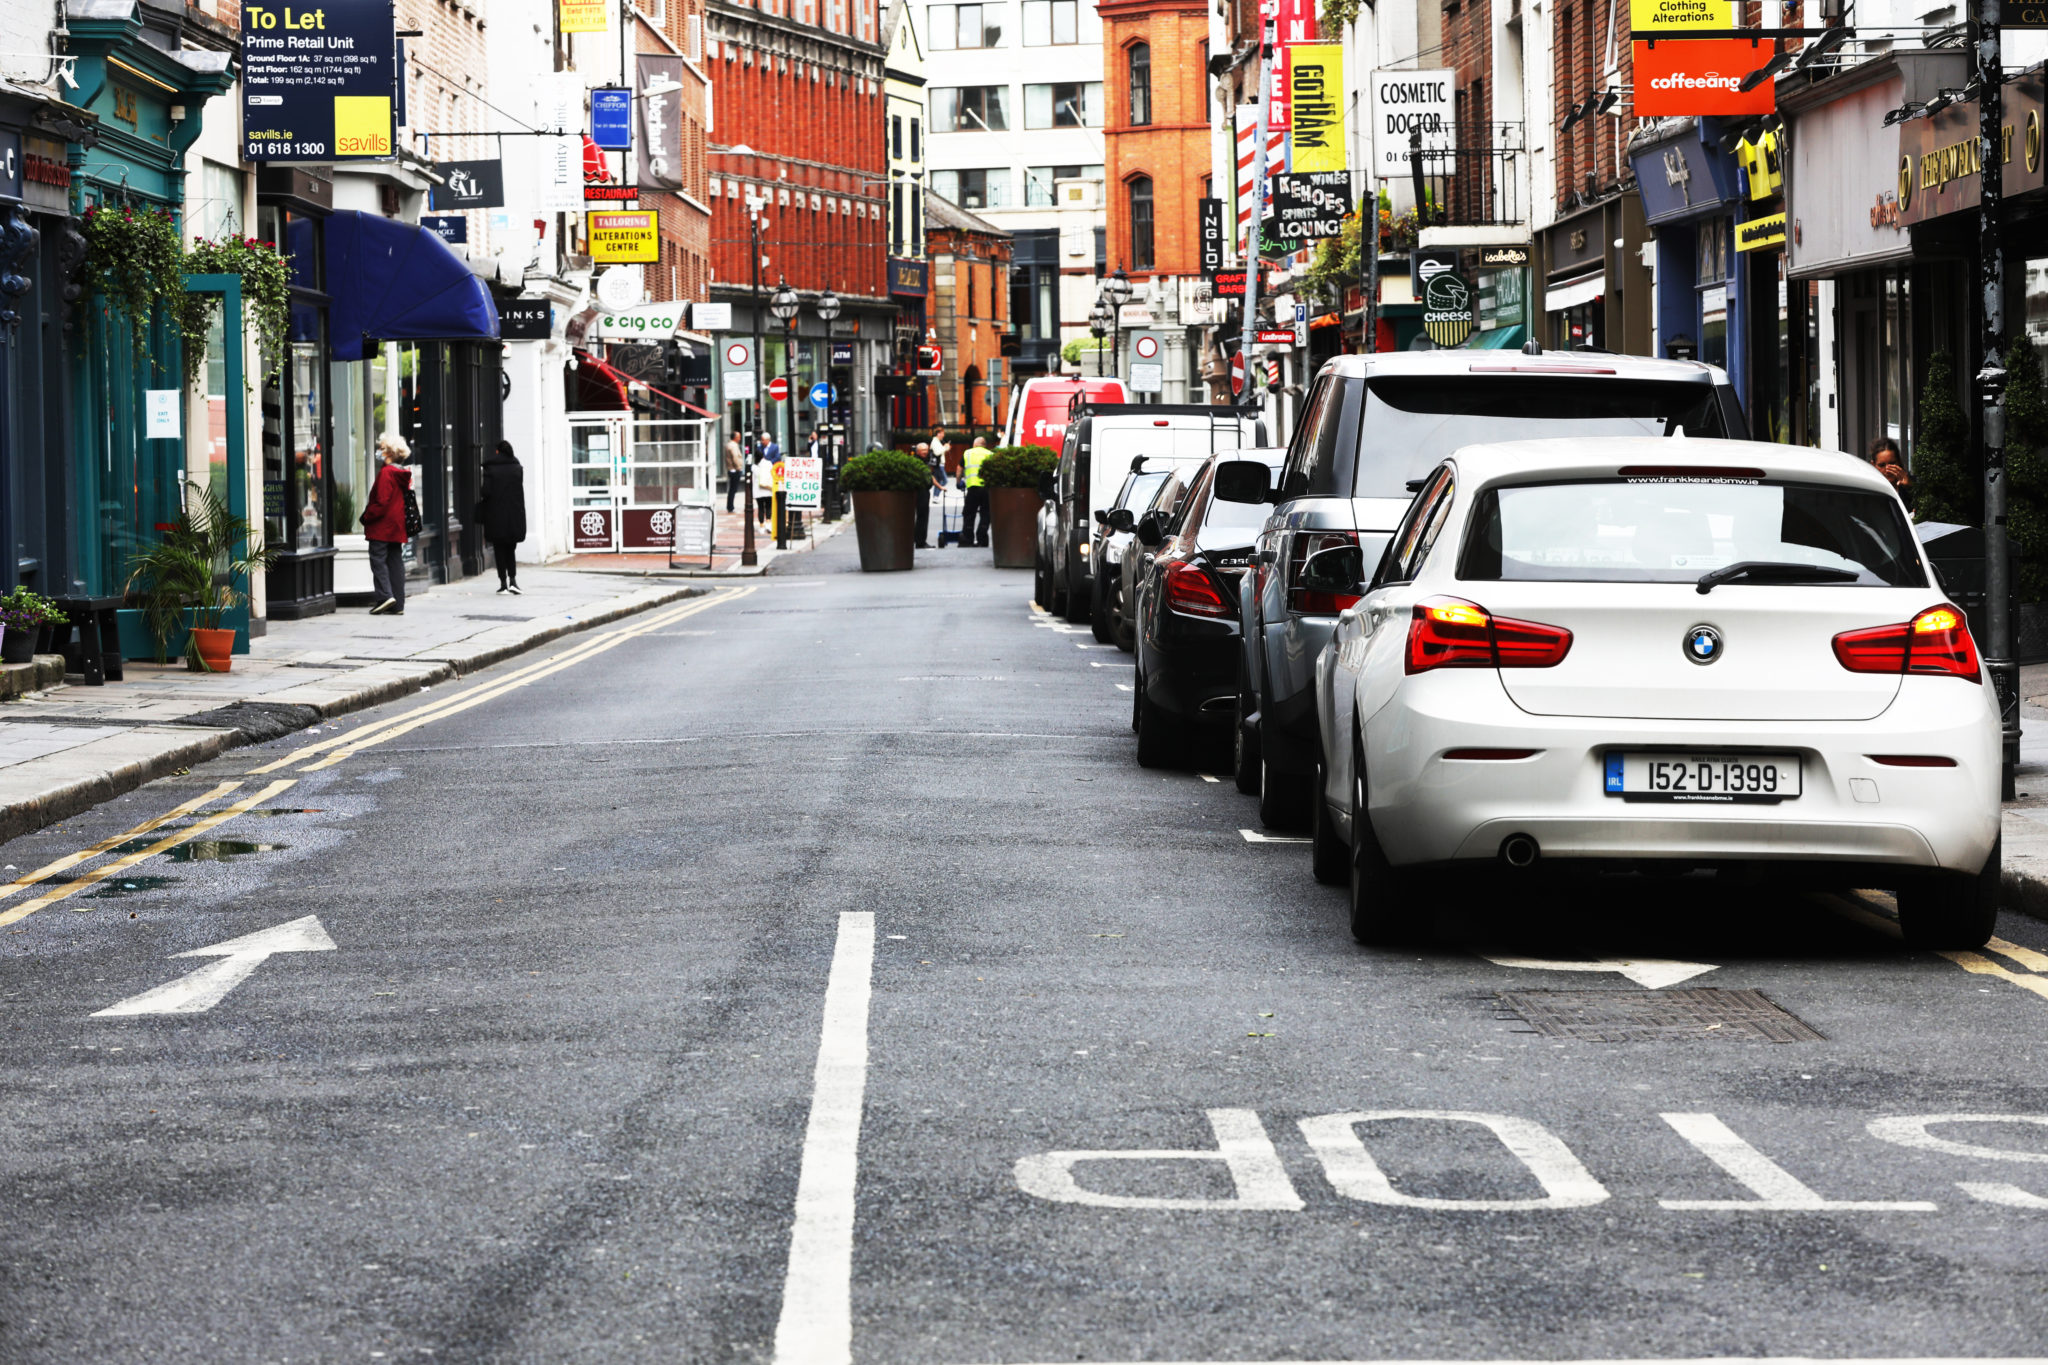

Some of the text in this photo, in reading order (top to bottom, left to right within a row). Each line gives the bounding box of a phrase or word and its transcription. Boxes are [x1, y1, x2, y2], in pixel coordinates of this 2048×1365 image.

[1660, 0, 1706, 11] Clothing
[246, 7, 325, 30] To Let
[1652, 12, 1714, 23] Alterations
[246, 36, 354, 48] Prime Retail Unit
[323, 66, 341, 74] (1744
[248, 76, 269, 84] Total:
[304, 77, 326, 85] (2,142
[337, 77, 345, 85] ft)
[1381, 82, 1446, 104] COSMETIC
[1294, 65, 1337, 147] GOTHAM
[1387, 113, 1441, 134] DOCTOR
[249, 129, 293, 140] savills.ie
[339, 134, 388, 151] savills
[248, 143, 325, 154] 01 618 1300
[1387, 152, 1397, 161] 01
[554, 143, 568, 187] Trinity
[1920, 150, 1940, 190] THE
[1310, 172, 1348, 186] WINES
[584, 187, 638, 199] RESTAURANT
[1279, 176, 1345, 214] KEHOES
[1282, 207, 1317, 220] SPIRITS
[598, 217, 647, 227] TAILORING
[594, 231, 652, 240] ALTERATIONS
[1205, 204, 1218, 271] INGLOT
[606, 243, 639, 251] CENTRE
[1485, 249, 1526, 263] isabelle's
[604, 316, 672, 331] e cig co
[792, 458, 815, 467] DO NOT
[787, 470, 819, 480] READ THIS
[786, 481, 791, 489] E
[802, 482, 819, 490] CIG
[1627, 476, 1759, 486] www.frankkeanebmw.ie
[789, 492, 816, 501] SHOP
[1608, 776, 1622, 786] IRL
[1649, 762, 1777, 792] 152-D-1399
